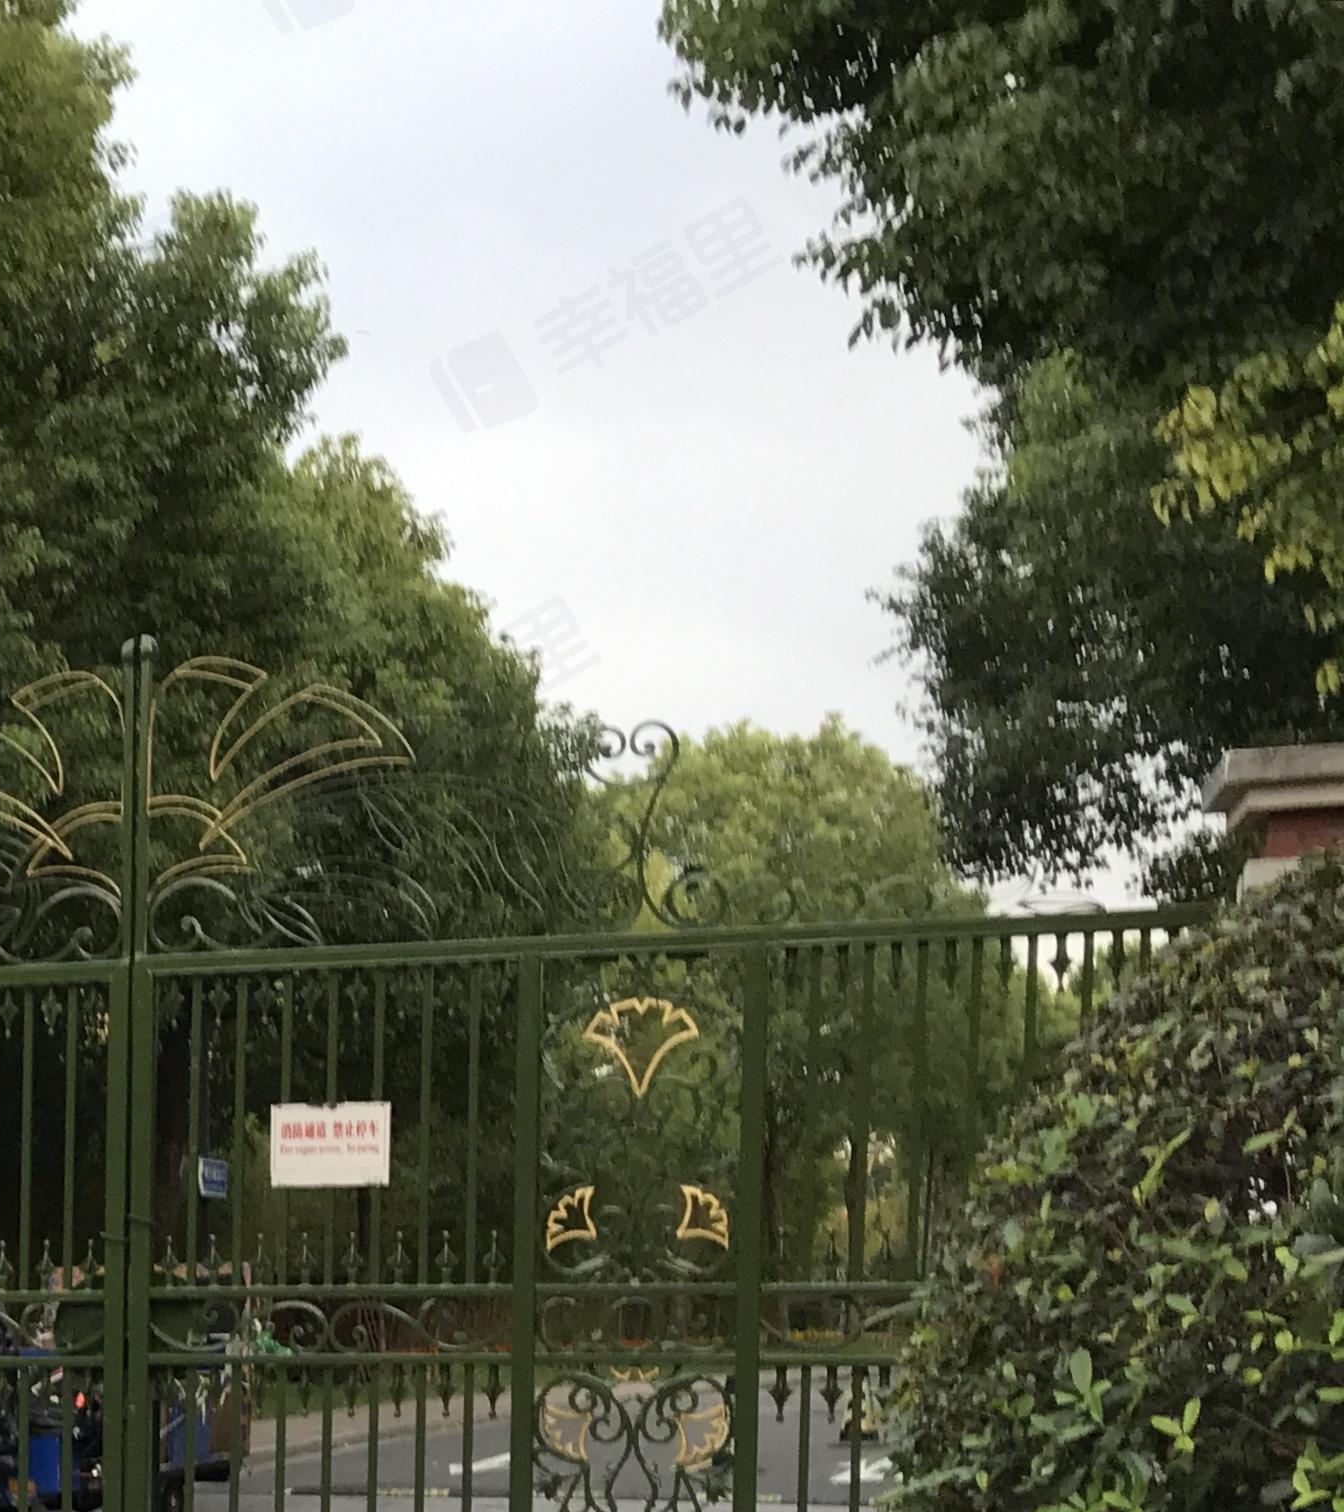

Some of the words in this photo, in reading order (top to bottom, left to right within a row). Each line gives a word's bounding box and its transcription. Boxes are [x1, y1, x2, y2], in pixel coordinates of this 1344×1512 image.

[281, 1120, 327, 1139] 消防通道
[333, 1119, 378, 1138] 禁止停车
